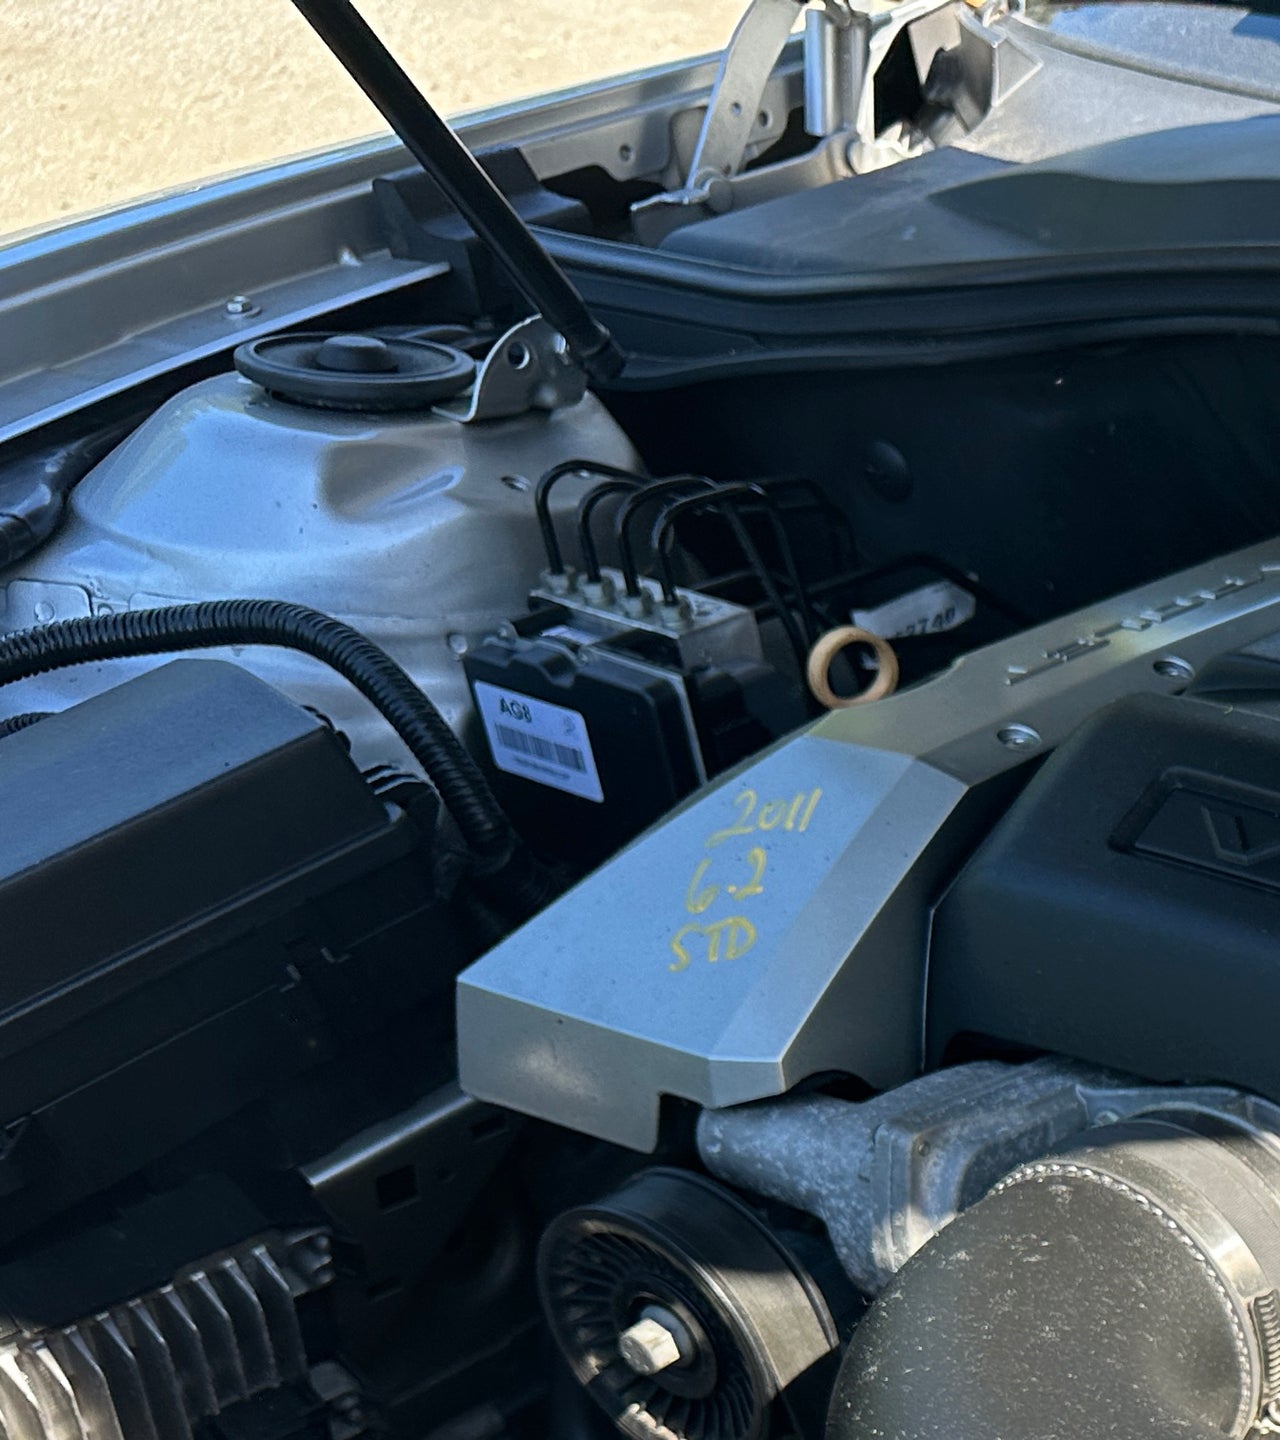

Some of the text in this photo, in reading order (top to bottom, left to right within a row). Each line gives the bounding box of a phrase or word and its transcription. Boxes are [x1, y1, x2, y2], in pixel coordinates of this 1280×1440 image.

[705, 788, 822, 849] 2011
[686, 848, 766, 914] 6.2
[668, 916, 758, 972] STD
